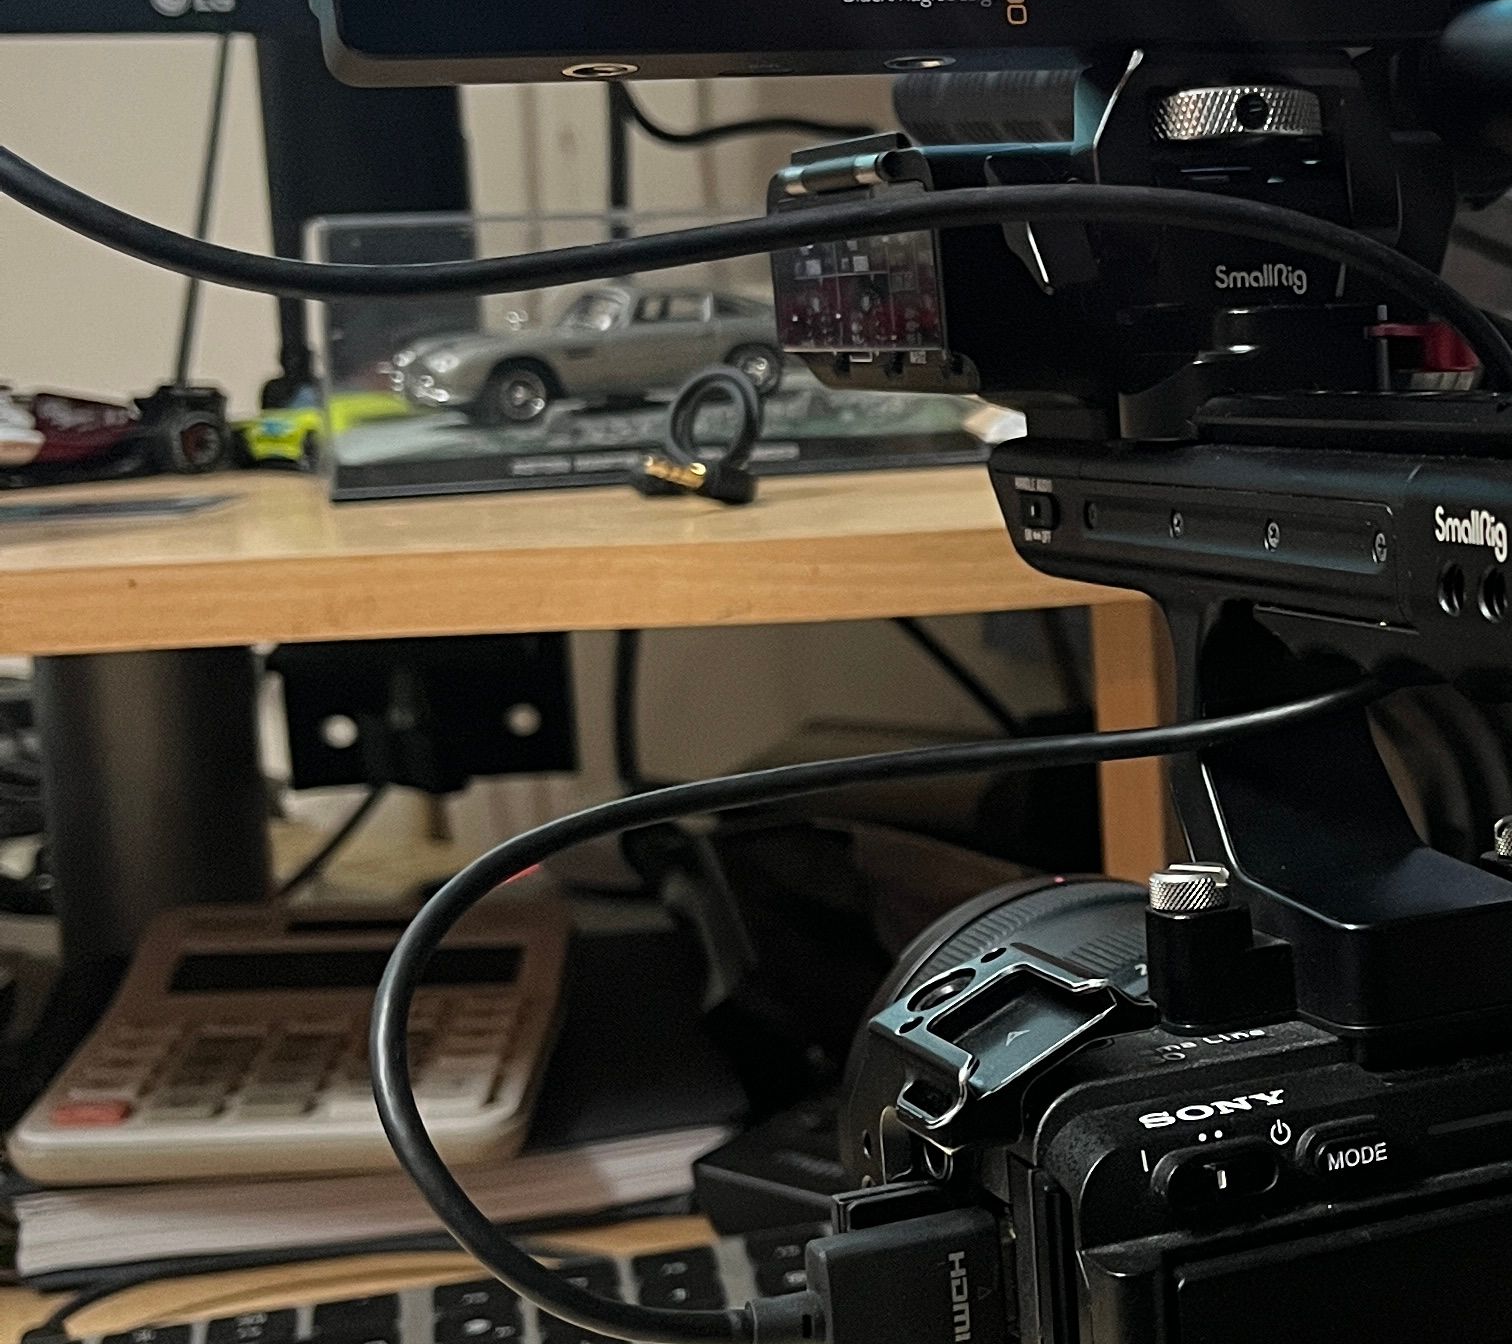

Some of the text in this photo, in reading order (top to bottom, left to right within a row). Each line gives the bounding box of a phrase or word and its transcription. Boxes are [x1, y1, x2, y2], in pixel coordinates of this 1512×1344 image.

[1215, 264, 1307, 295] SmallRig
[1435, 505, 1508, 563] SmallRig
[1138, 1089, 1284, 1129] SONY
[1327, 1142, 1388, 1171] MODE
[948, 1251, 971, 1342] HDMI
